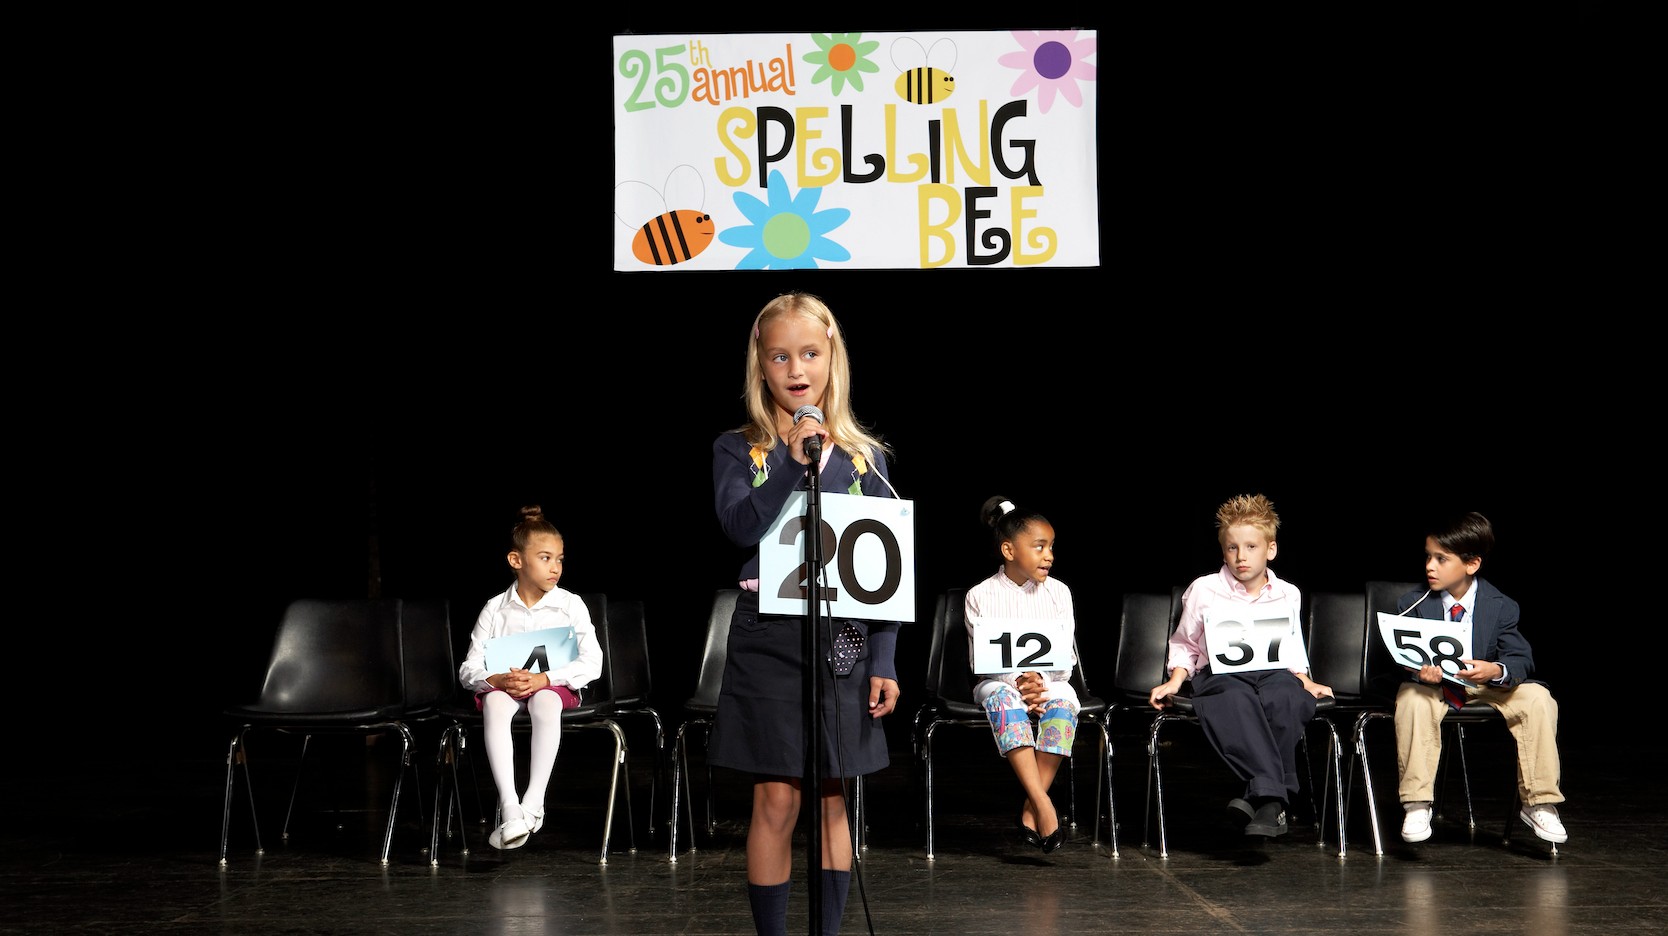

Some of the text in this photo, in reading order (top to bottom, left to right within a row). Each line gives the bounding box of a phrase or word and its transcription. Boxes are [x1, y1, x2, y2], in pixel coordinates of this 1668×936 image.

[618, 40, 796, 113] 25th annual
[714, 99, 1042, 189] SPELLING
[917, 183, 1058, 269] BEE
[777, 515, 902, 605] 20
[989, 632, 1054, 668] 12
[1215, 617, 1289, 666] 37
[1393, 629, 1468, 677] 58
